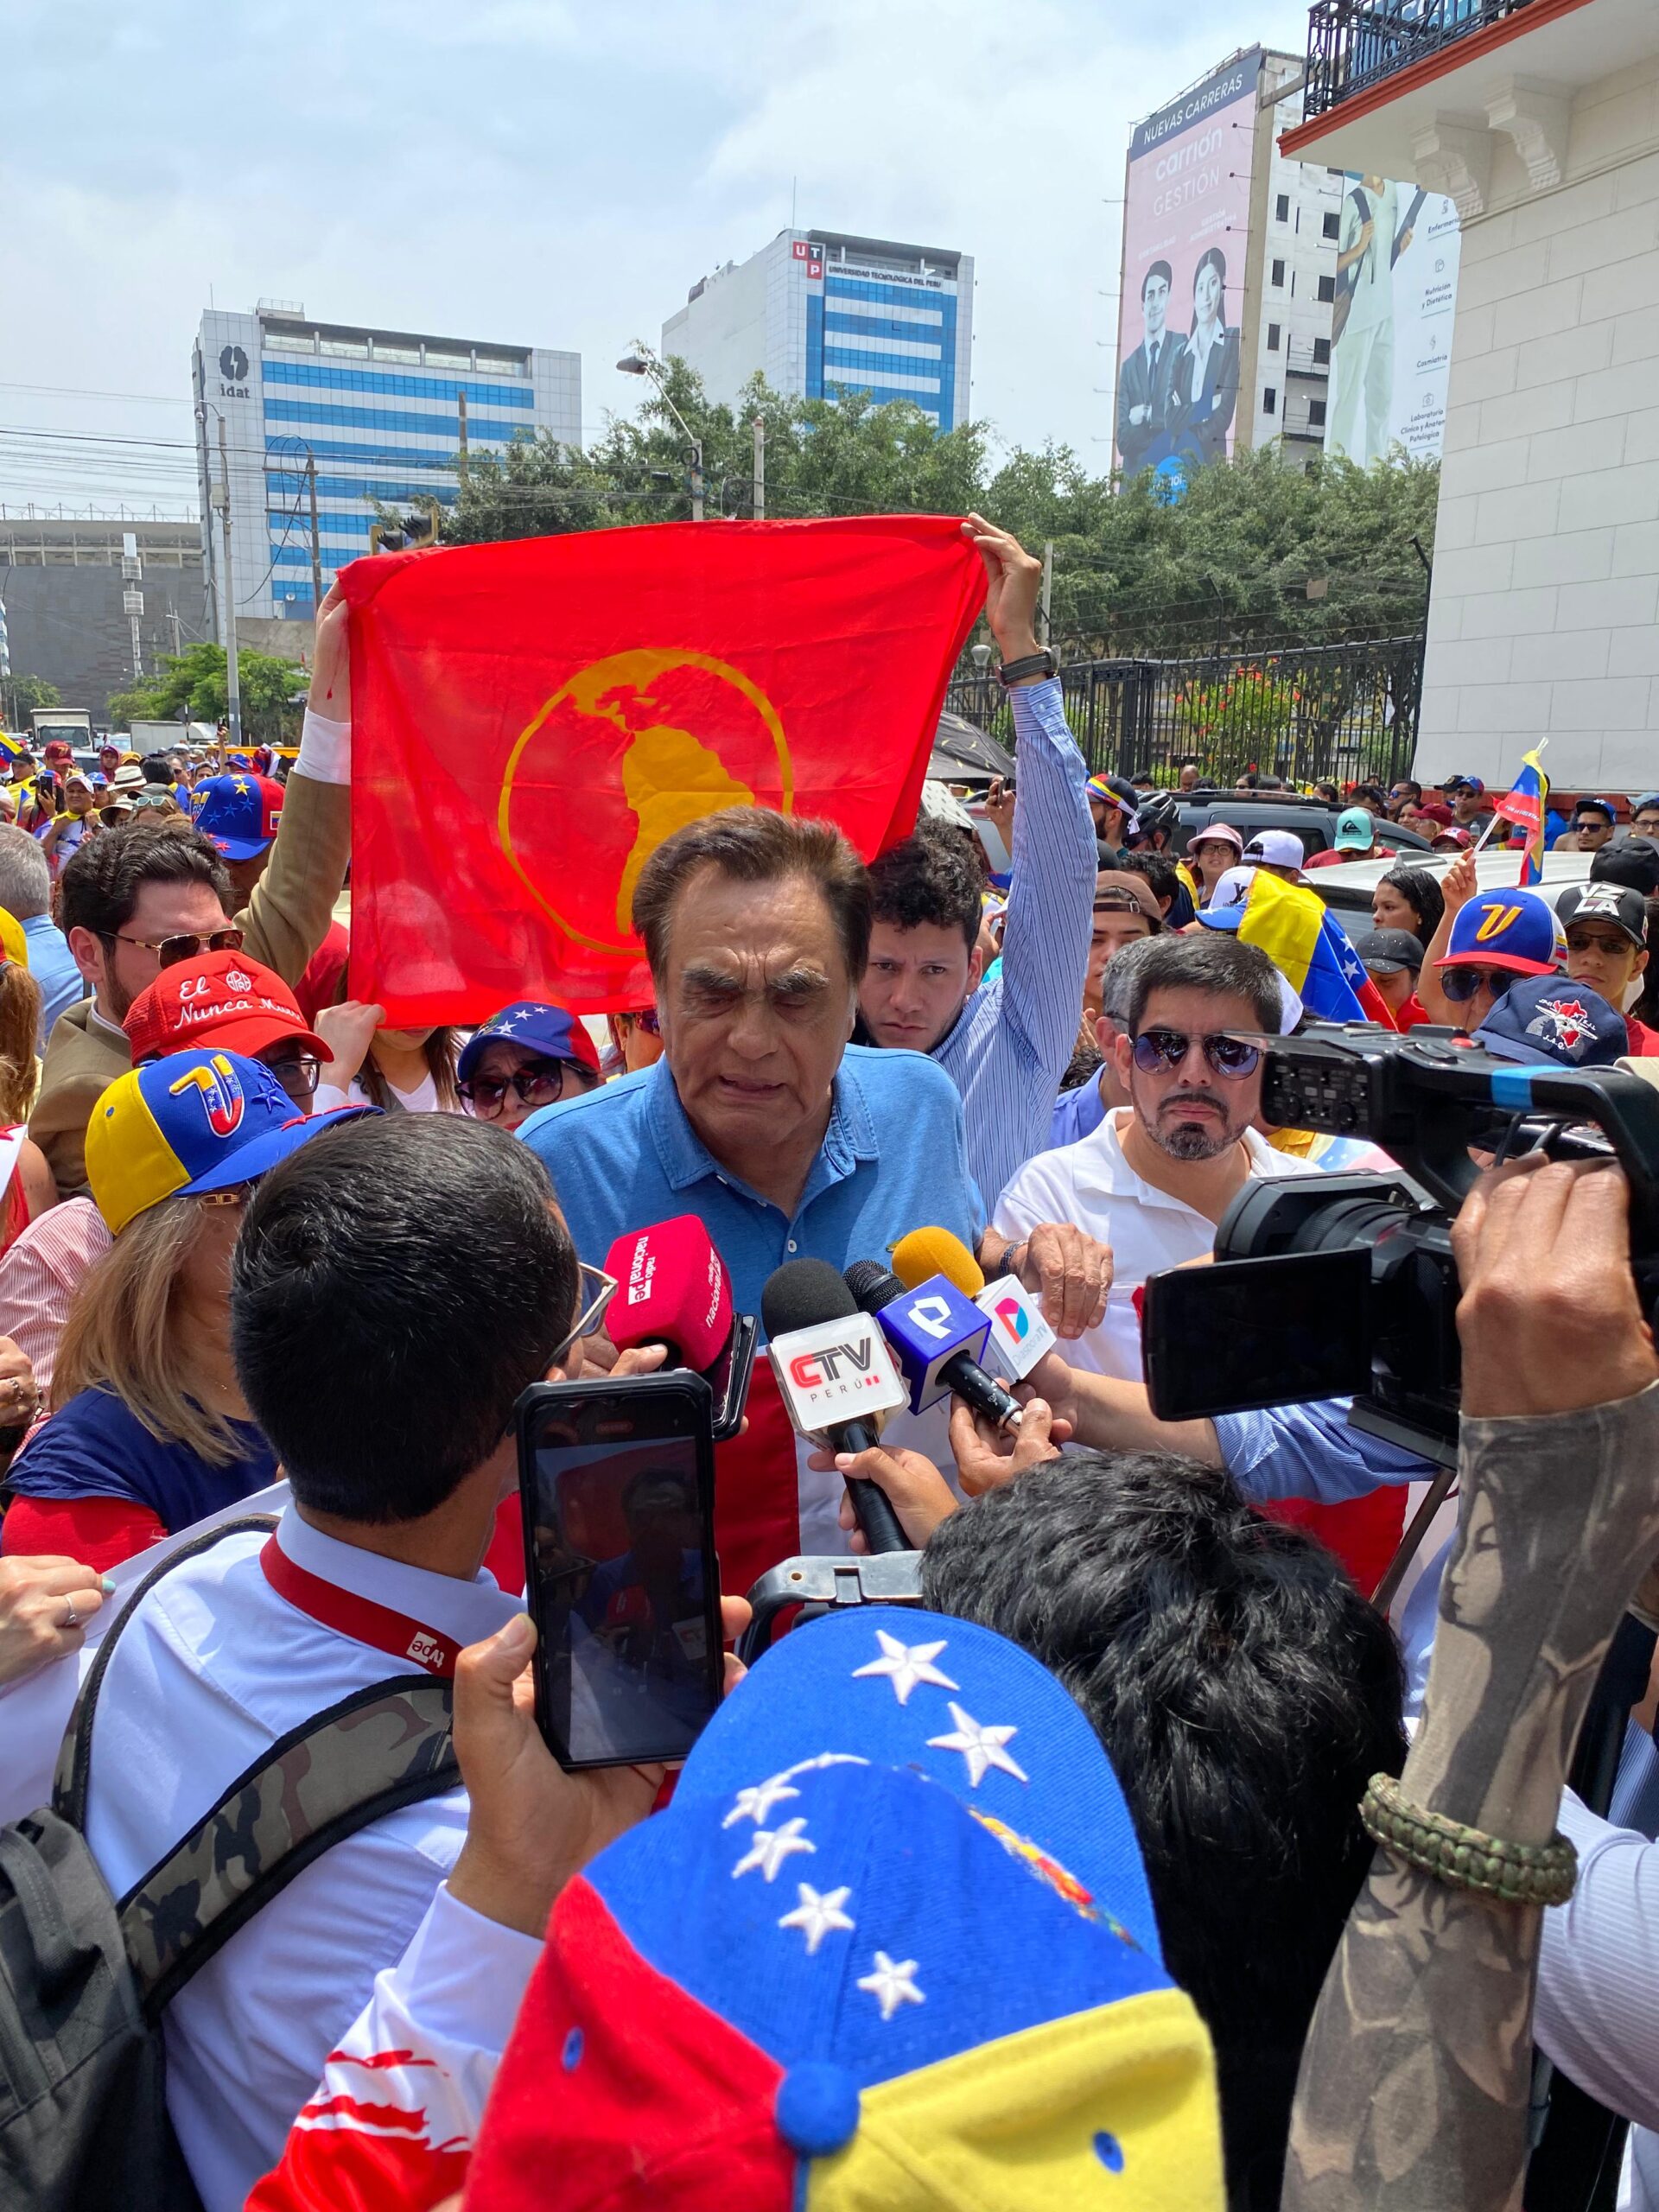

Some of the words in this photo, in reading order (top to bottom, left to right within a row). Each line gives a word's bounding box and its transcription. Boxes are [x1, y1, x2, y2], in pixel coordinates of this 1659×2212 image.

[1143, 110, 1183, 145] NUEVAS
[1185, 73, 1243, 119] CARRERAS
[1154, 165, 1220, 216] GESTIÓN
[829, 266, 870, 277] UNIVERSIDAD
[220, 383, 251, 399] idat
[179, 976, 211, 1000] El
[174, 999, 253, 1030] Nunca
[629, 1236, 650, 1286] nacional
[645, 1255, 657, 1280] radio
[790, 1337, 871, 1389] CTV
[810, 1379, 862, 1402] PERÚ
